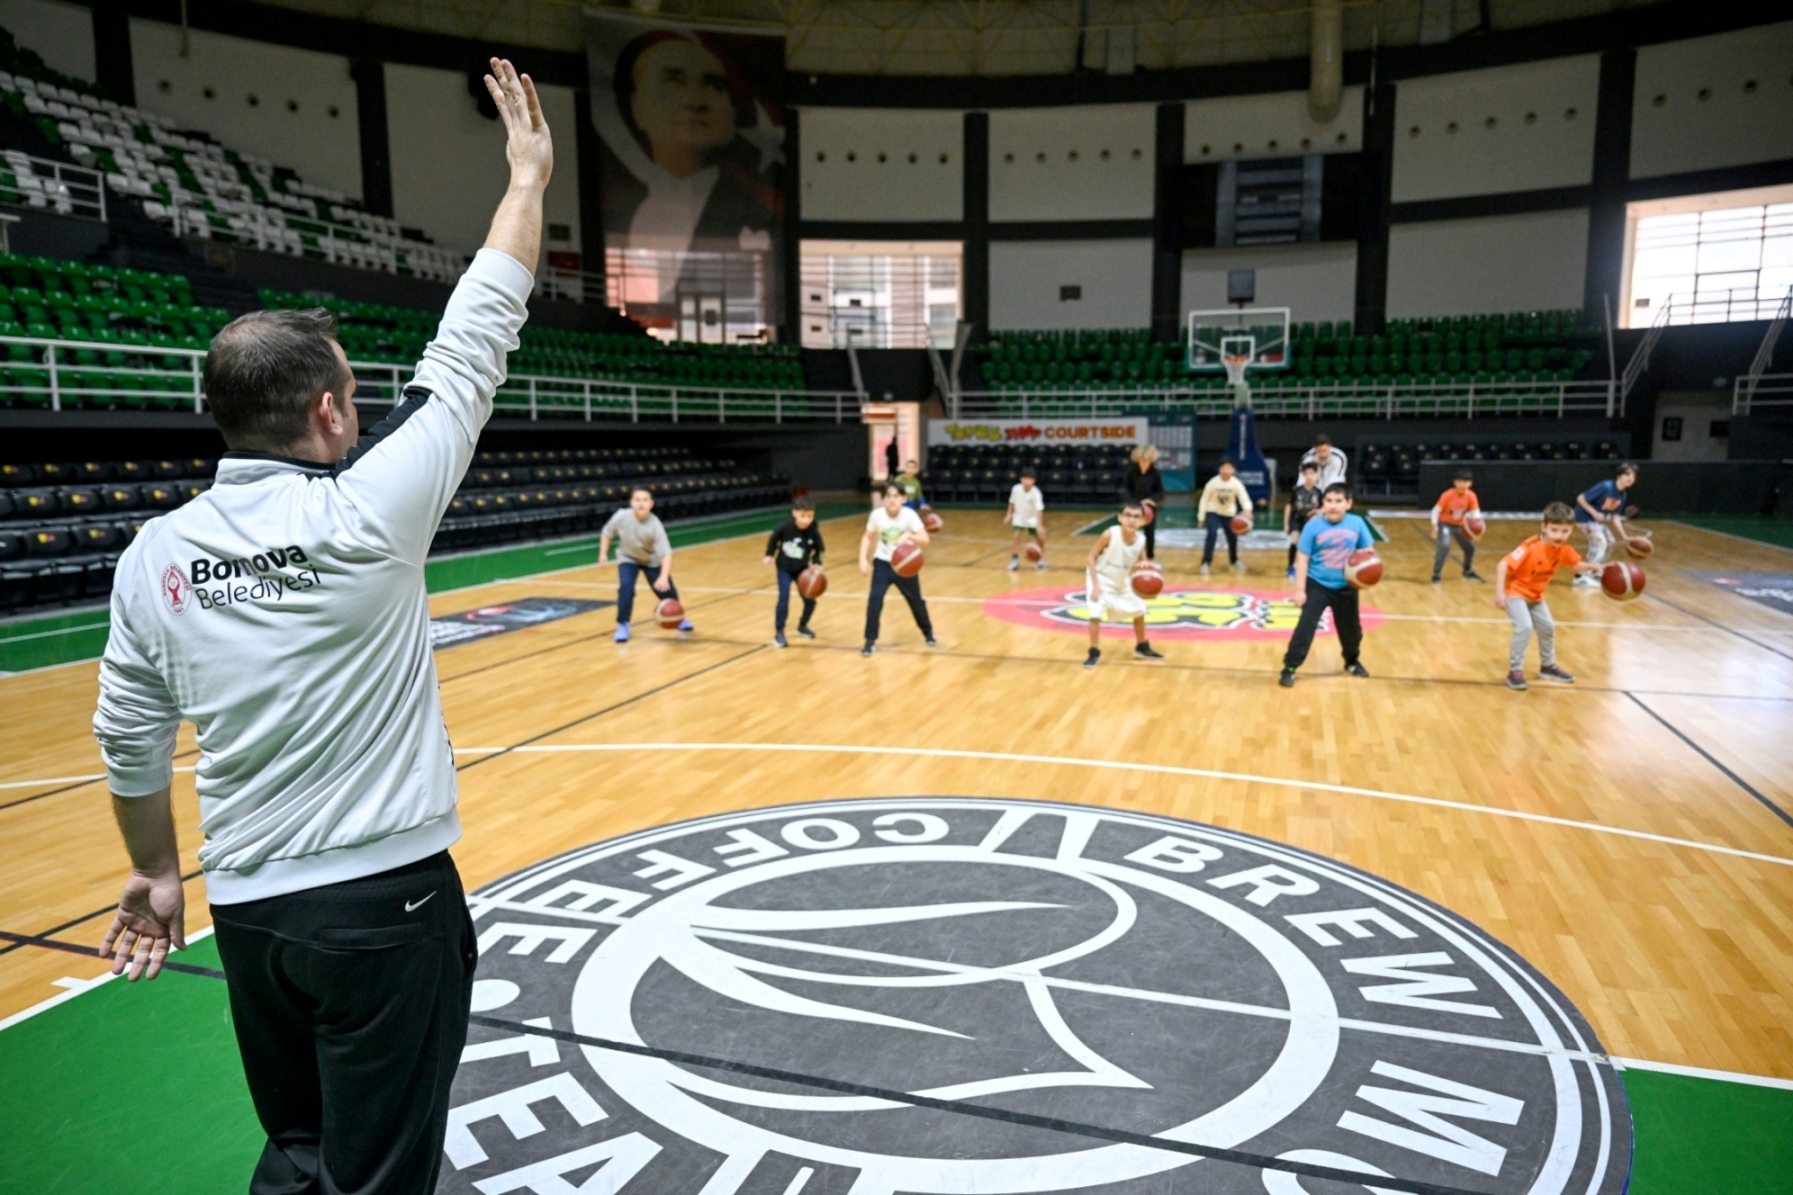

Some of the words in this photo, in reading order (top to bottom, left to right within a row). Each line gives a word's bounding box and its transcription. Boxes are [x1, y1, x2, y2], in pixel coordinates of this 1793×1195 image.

[1045, 425, 1136, 439] COURTSIDE
[191, 545, 309, 585] Bornova
[195, 563, 321, 610] Belediyesi
[477, 812, 949, 964] COFFEE
[1123, 835, 1504, 1020] BREW
